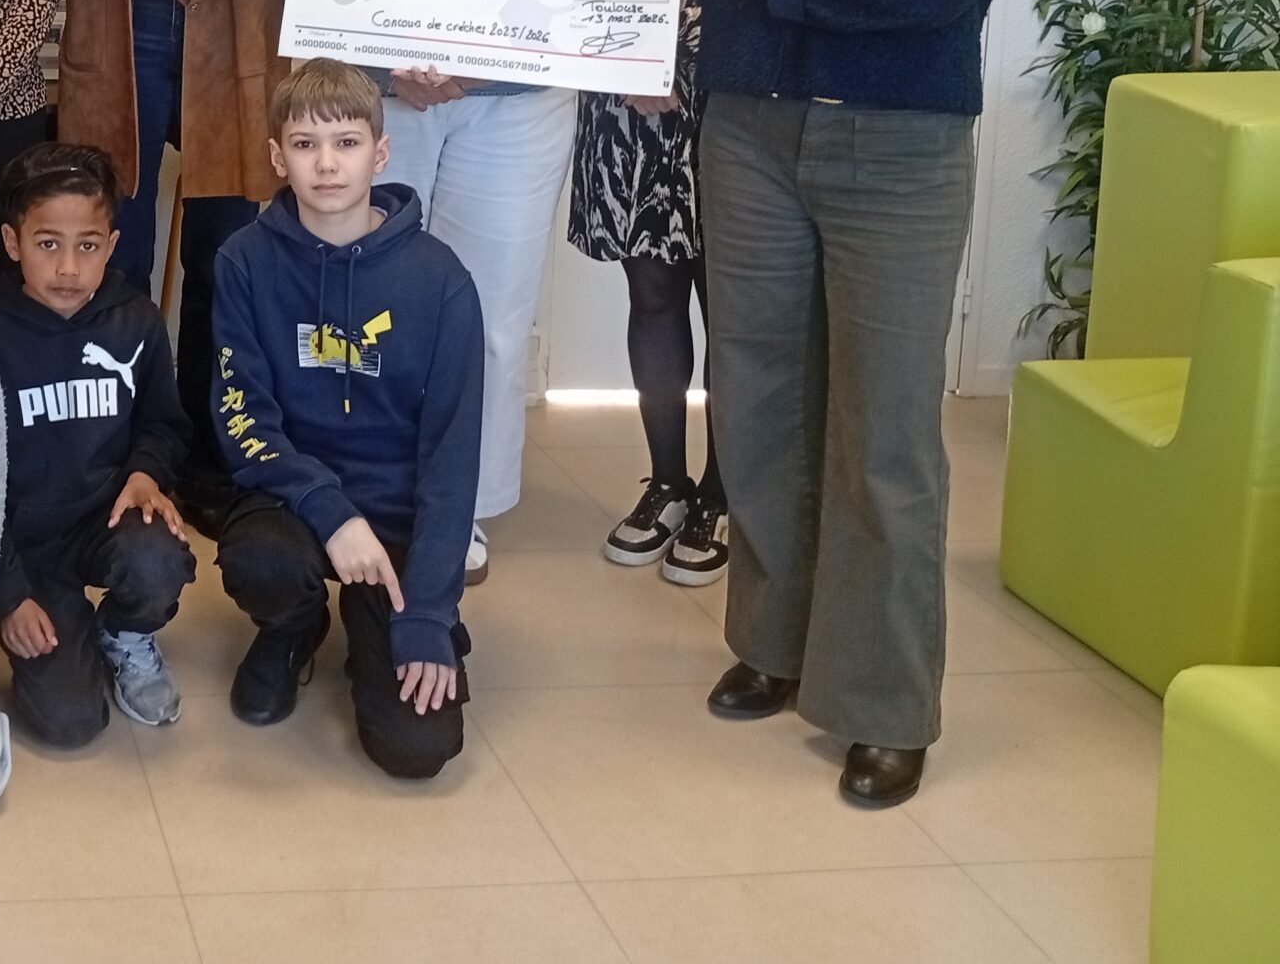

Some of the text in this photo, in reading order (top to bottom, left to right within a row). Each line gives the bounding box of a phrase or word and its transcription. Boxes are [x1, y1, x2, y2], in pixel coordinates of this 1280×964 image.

[581, 0, 645, 14] Toulouse
[426, 17, 441, 30] de
[18, 377, 118, 428] PUMA
